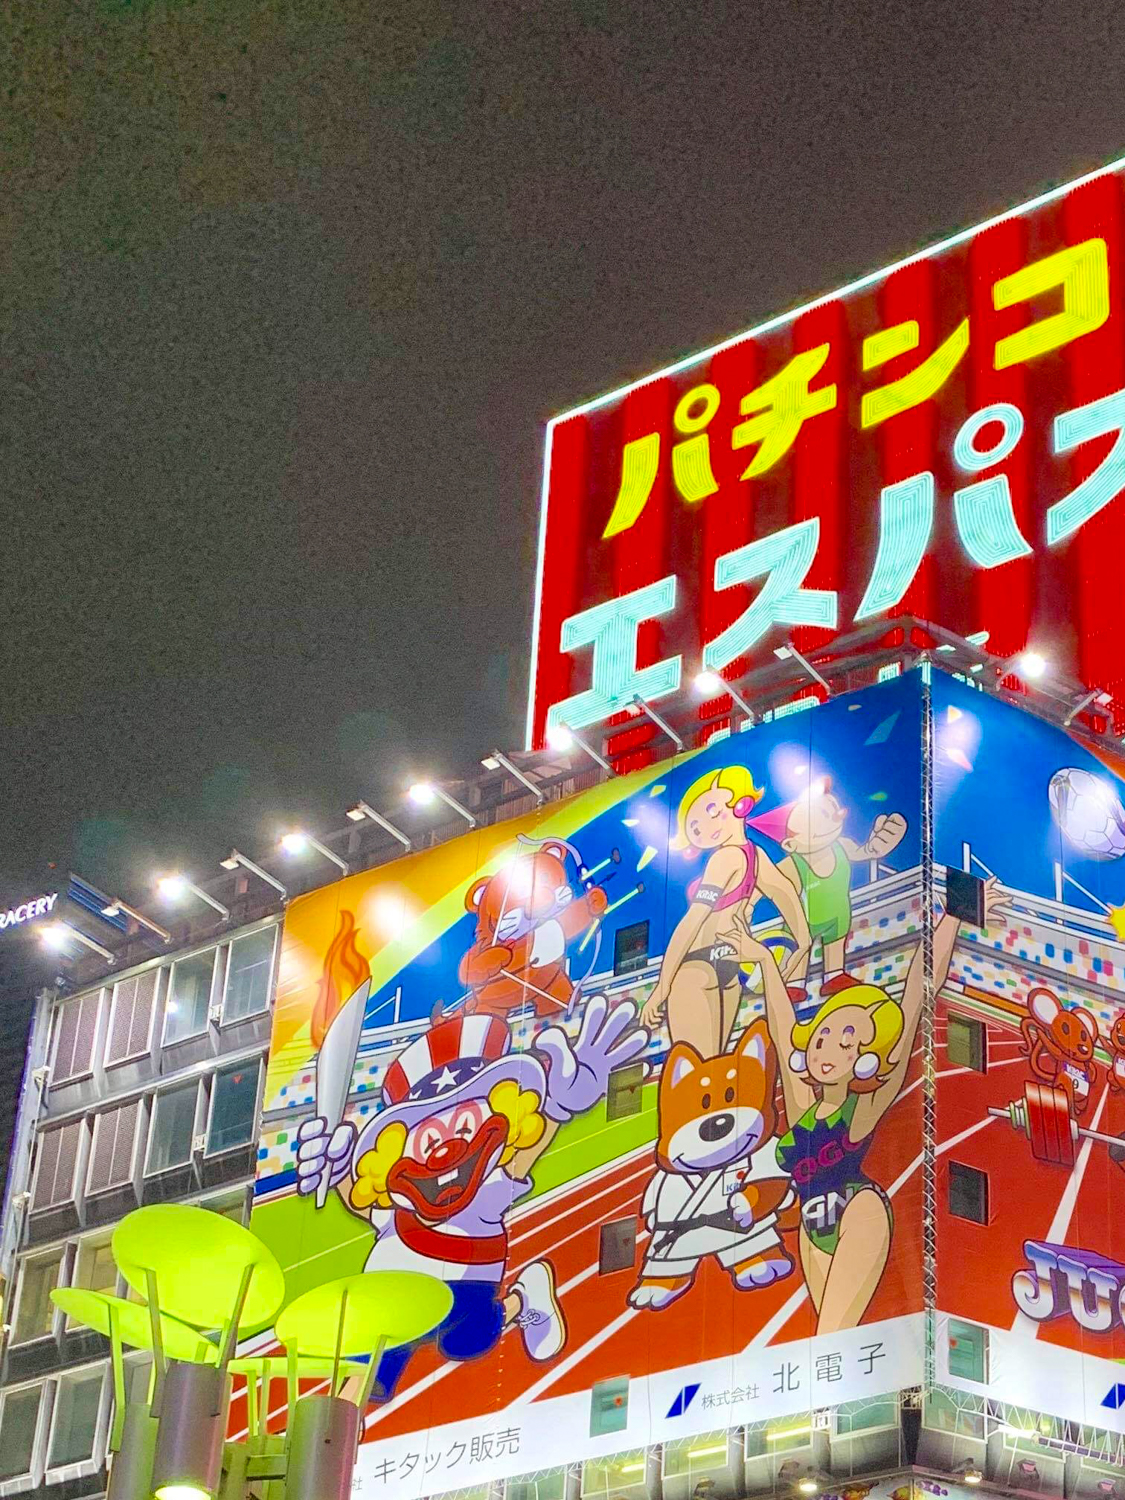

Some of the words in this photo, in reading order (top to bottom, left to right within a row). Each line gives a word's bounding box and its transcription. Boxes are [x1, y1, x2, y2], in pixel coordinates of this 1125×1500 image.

[601, 237, 1112, 539] パチンコ
[701, 1384, 760, 1410] 株式会社
[772, 1342, 888, 1395] 北電子
[374, 1427, 521, 1485] キタック販売
